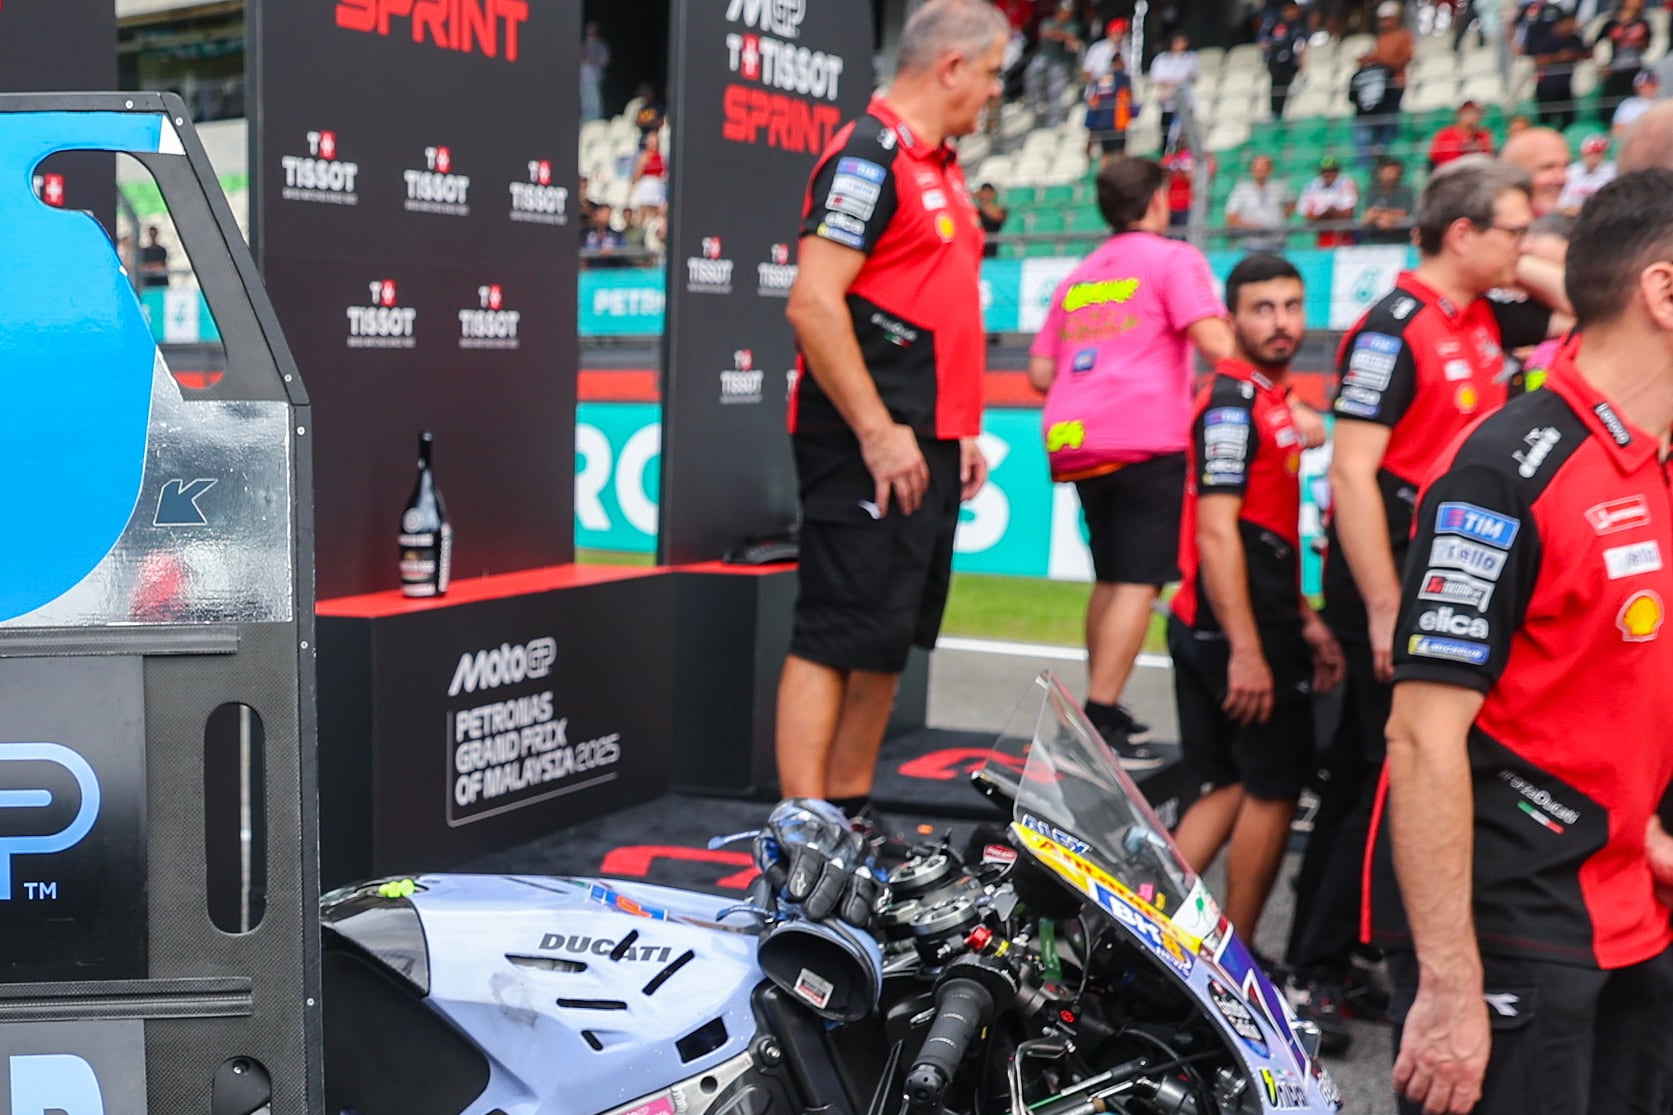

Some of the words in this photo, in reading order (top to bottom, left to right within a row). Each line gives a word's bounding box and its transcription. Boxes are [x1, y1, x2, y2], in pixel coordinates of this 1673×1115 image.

[760, 44, 843, 100] TISSOT
[723, 83, 841, 155] SPRINT
[282, 155, 358, 193] TISSOT
[404, 170, 470, 204] TISSOT
[509, 182, 568, 215] TISSOT
[688, 257, 733, 285] TISSOT
[346, 306, 417, 337] TISSOT
[458, 309, 520, 338] TISSOT
[720, 370, 763, 396] TISSOT
[1464, 513, 1505, 541] TIM
[1419, 606, 1490, 640] elica
[455, 691, 553, 743] PETRONAS
[455, 730, 520, 774] GRAND
[521, 717, 568, 758] PRIX
[455, 773, 483, 806] OF
[483, 747, 577, 800] MALAYSIA
[577, 733, 621, 775] 2025
[538, 932, 673, 963] DUCATI
